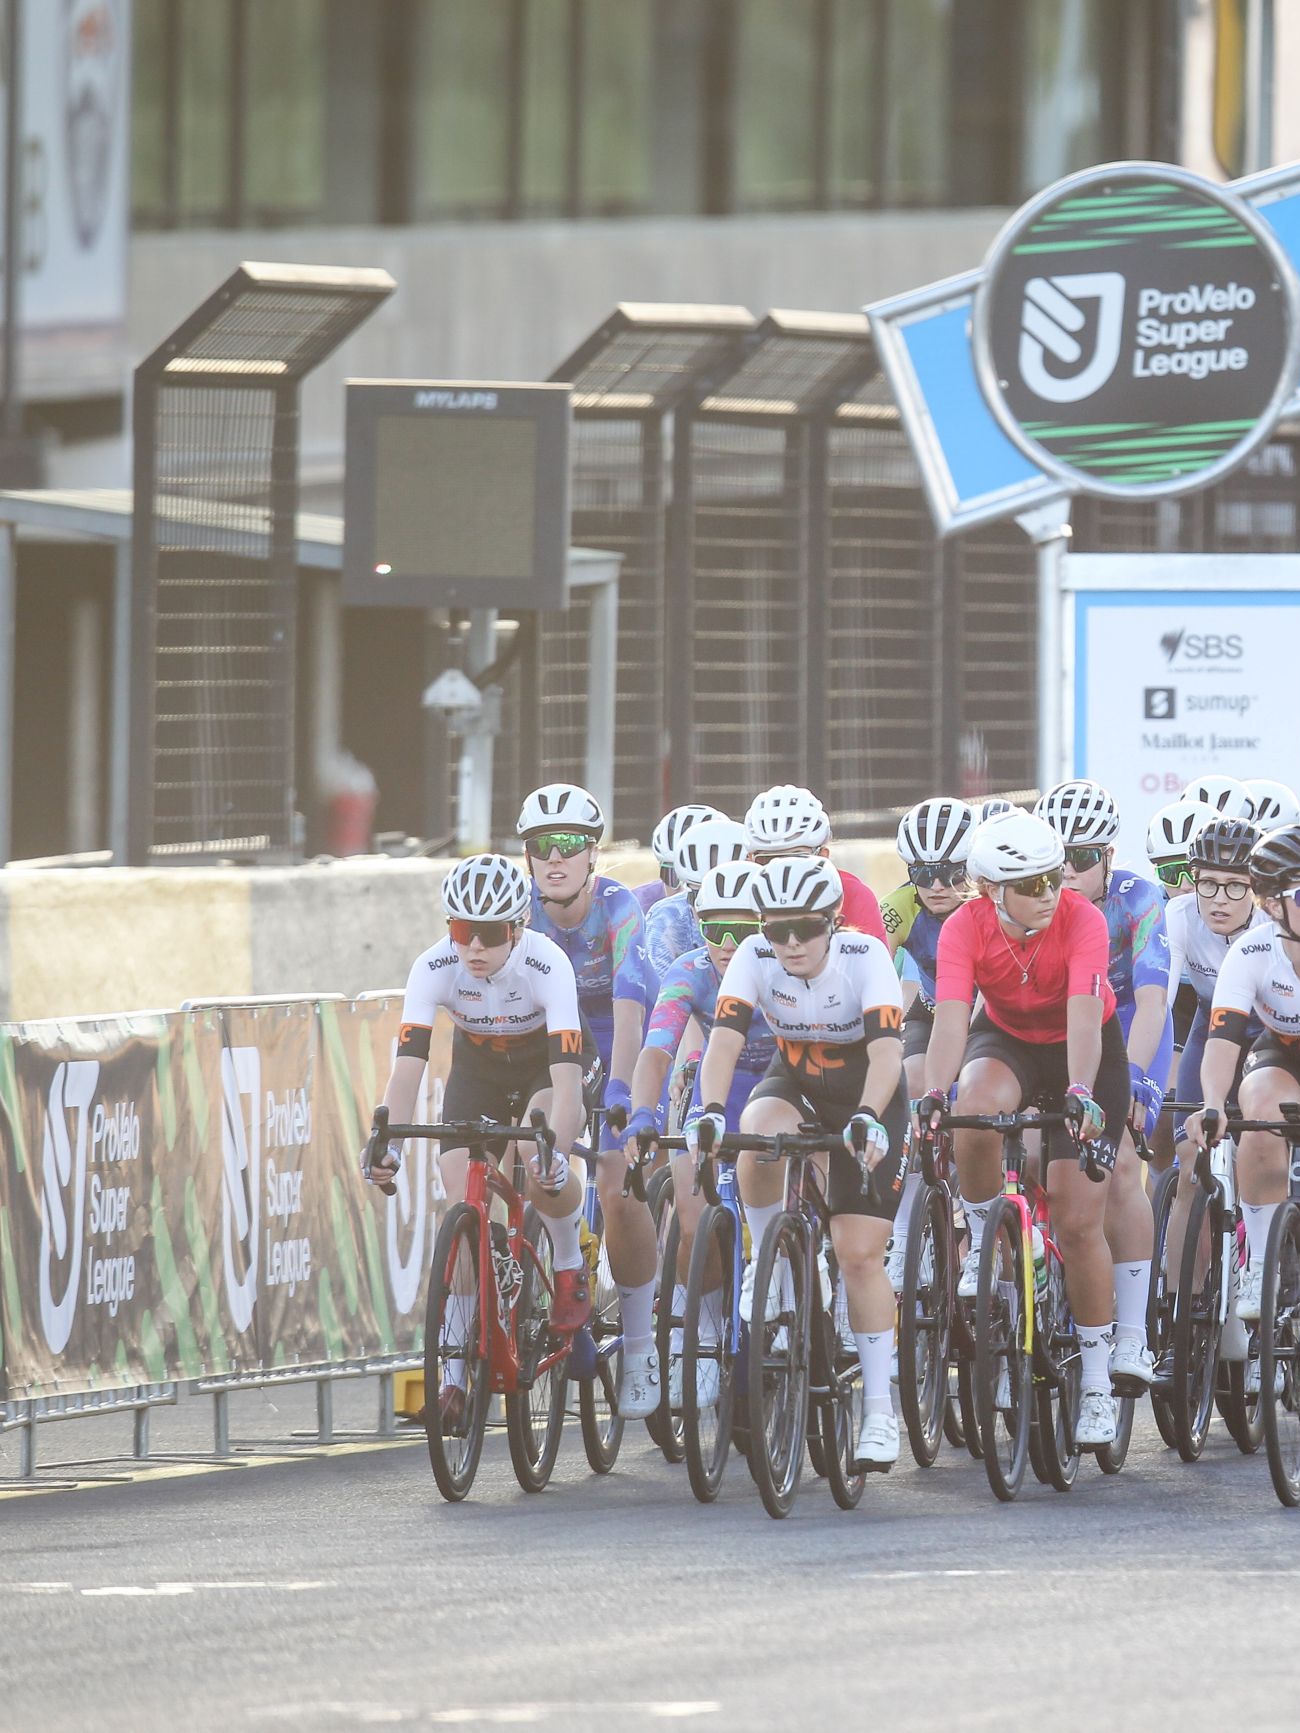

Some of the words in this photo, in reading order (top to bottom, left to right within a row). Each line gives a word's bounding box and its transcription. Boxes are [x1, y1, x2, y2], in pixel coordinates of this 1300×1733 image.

[1138, 282, 1256, 317] ProVelo
[1136, 318, 1233, 350] Super
[1133, 347, 1248, 380] League
[415, 390, 498, 410] MYLAPS
[1184, 634, 1244, 660] SBS
[1186, 694, 1251, 716] sumup
[1142, 733, 1204, 749] Maillot
[1210, 734, 1260, 751] Jaune
[428, 955, 459, 971] BOMAD
[840, 944, 869, 955] BOMAD
[1241, 944, 1272, 955] BOMAD
[525, 956, 551, 975] BOMAD
[772, 989, 797, 1003] BOMAD
[92, 1101, 140, 1163] ProVelo
[266, 1087, 312, 1148] ProVelo
[266, 1158, 303, 1227] Super
[89, 1173, 131, 1245] Super
[265, 1227, 312, 1297] League
[87, 1244, 135, 1317] League
